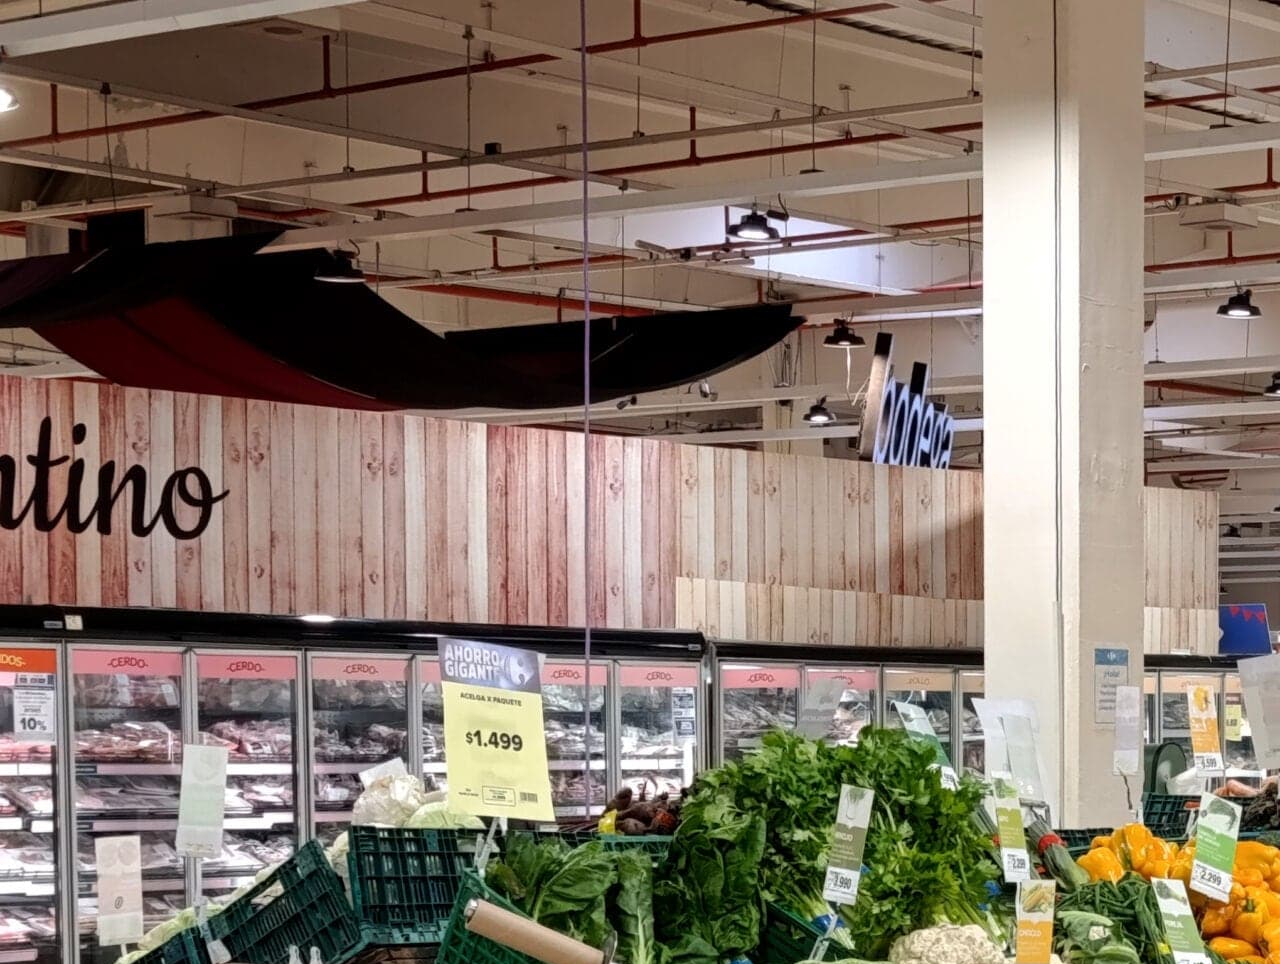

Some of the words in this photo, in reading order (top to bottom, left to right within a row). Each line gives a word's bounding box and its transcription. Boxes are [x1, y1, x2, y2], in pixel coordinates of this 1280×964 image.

[444, 644, 500, 666] AHORRO
[444, 661, 500, 682] GIGANTE
[19, 717, 47, 732] 10%
[465, 730, 523, 752] $1.499
